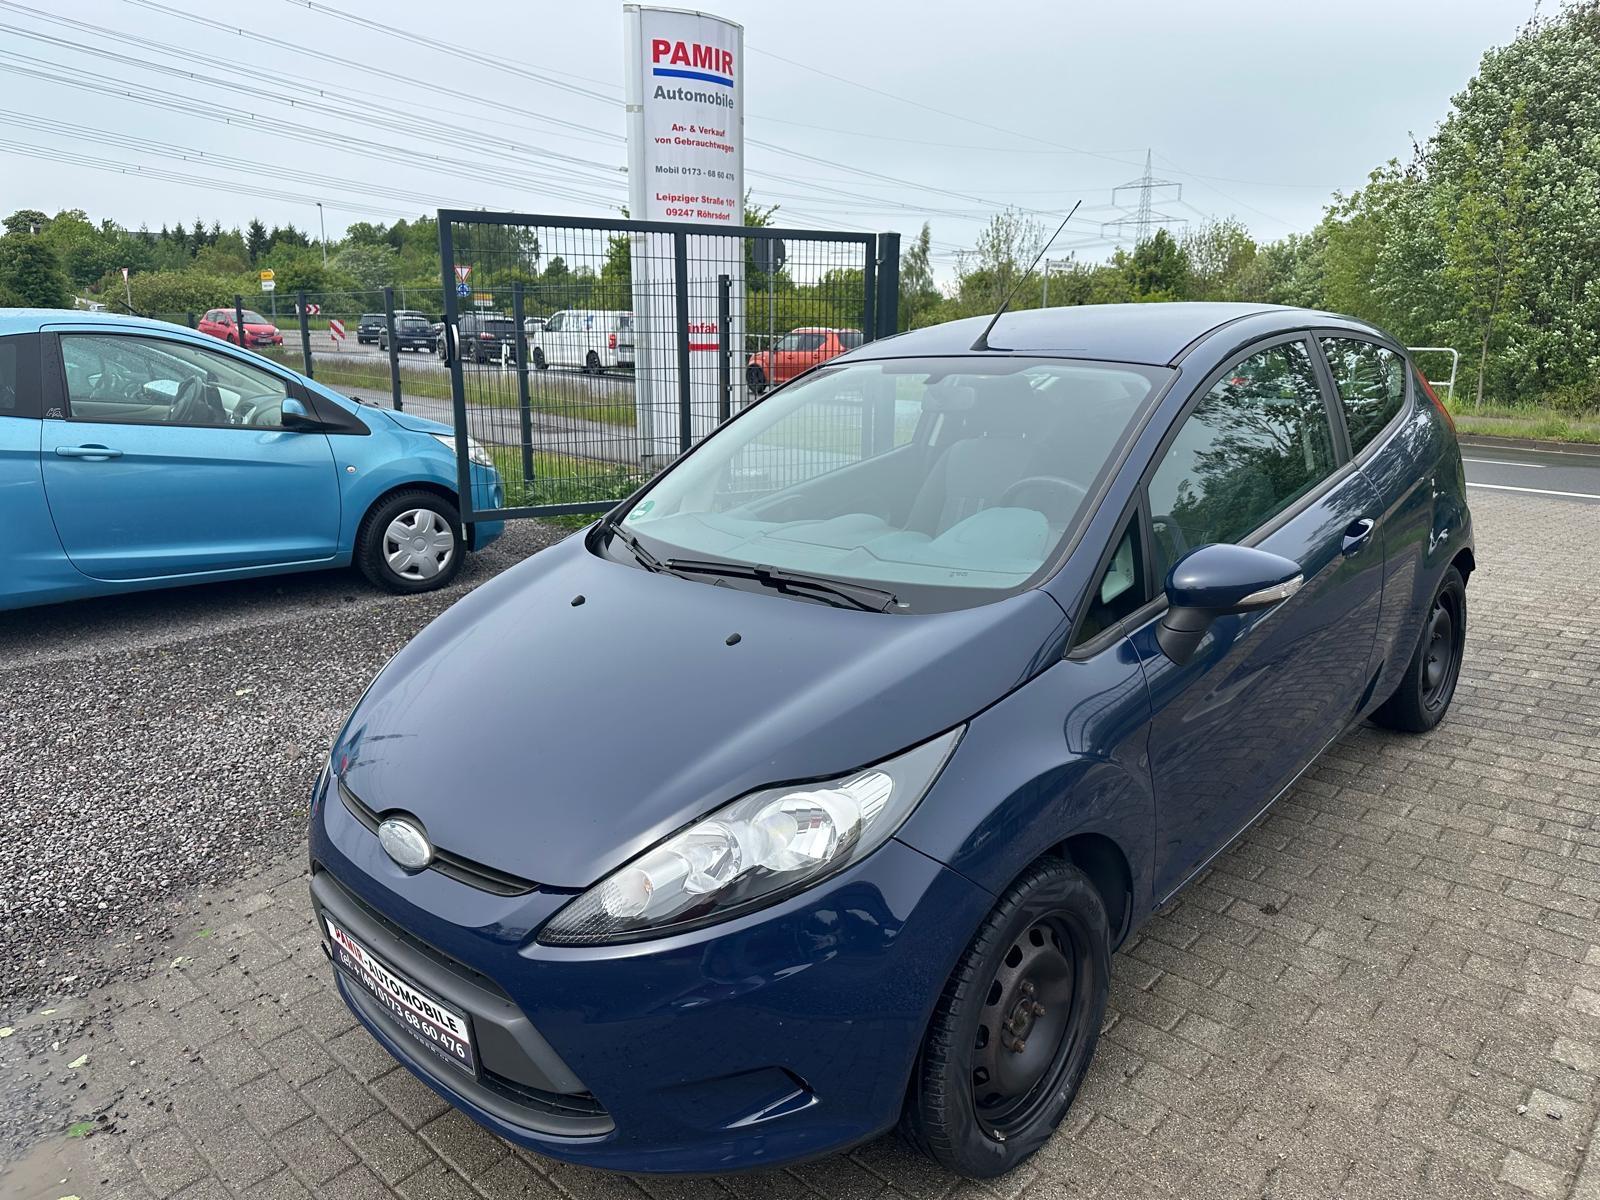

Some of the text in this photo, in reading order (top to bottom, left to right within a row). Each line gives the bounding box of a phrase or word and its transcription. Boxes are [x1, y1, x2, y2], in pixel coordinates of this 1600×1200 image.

[652, 39, 734, 76] PAMIR
[654, 85, 734, 109] Automobile
[671, 123, 687, 132] An-
[698, 125, 725, 137] Verkauf
[655, 136, 735, 153] von Gebrauchtwagen
[655, 165, 679, 174] Mobil
[681, 167, 702, 176] 0173
[707, 170, 716, 178] 68
[717, 171, 725, 179] 60
[725, 173, 735, 181] 476
[656, 193, 699, 204] Leipziger
[701, 195, 725, 206] Straße
[665, 208, 730, 221] 09247 Röhrsdorf
[688, 322, 718, 334] infah
[404, 1010, 420, 1029] 68
[422, 1021, 438, 1040] 60
[440, 1033, 465, 1058] 476
